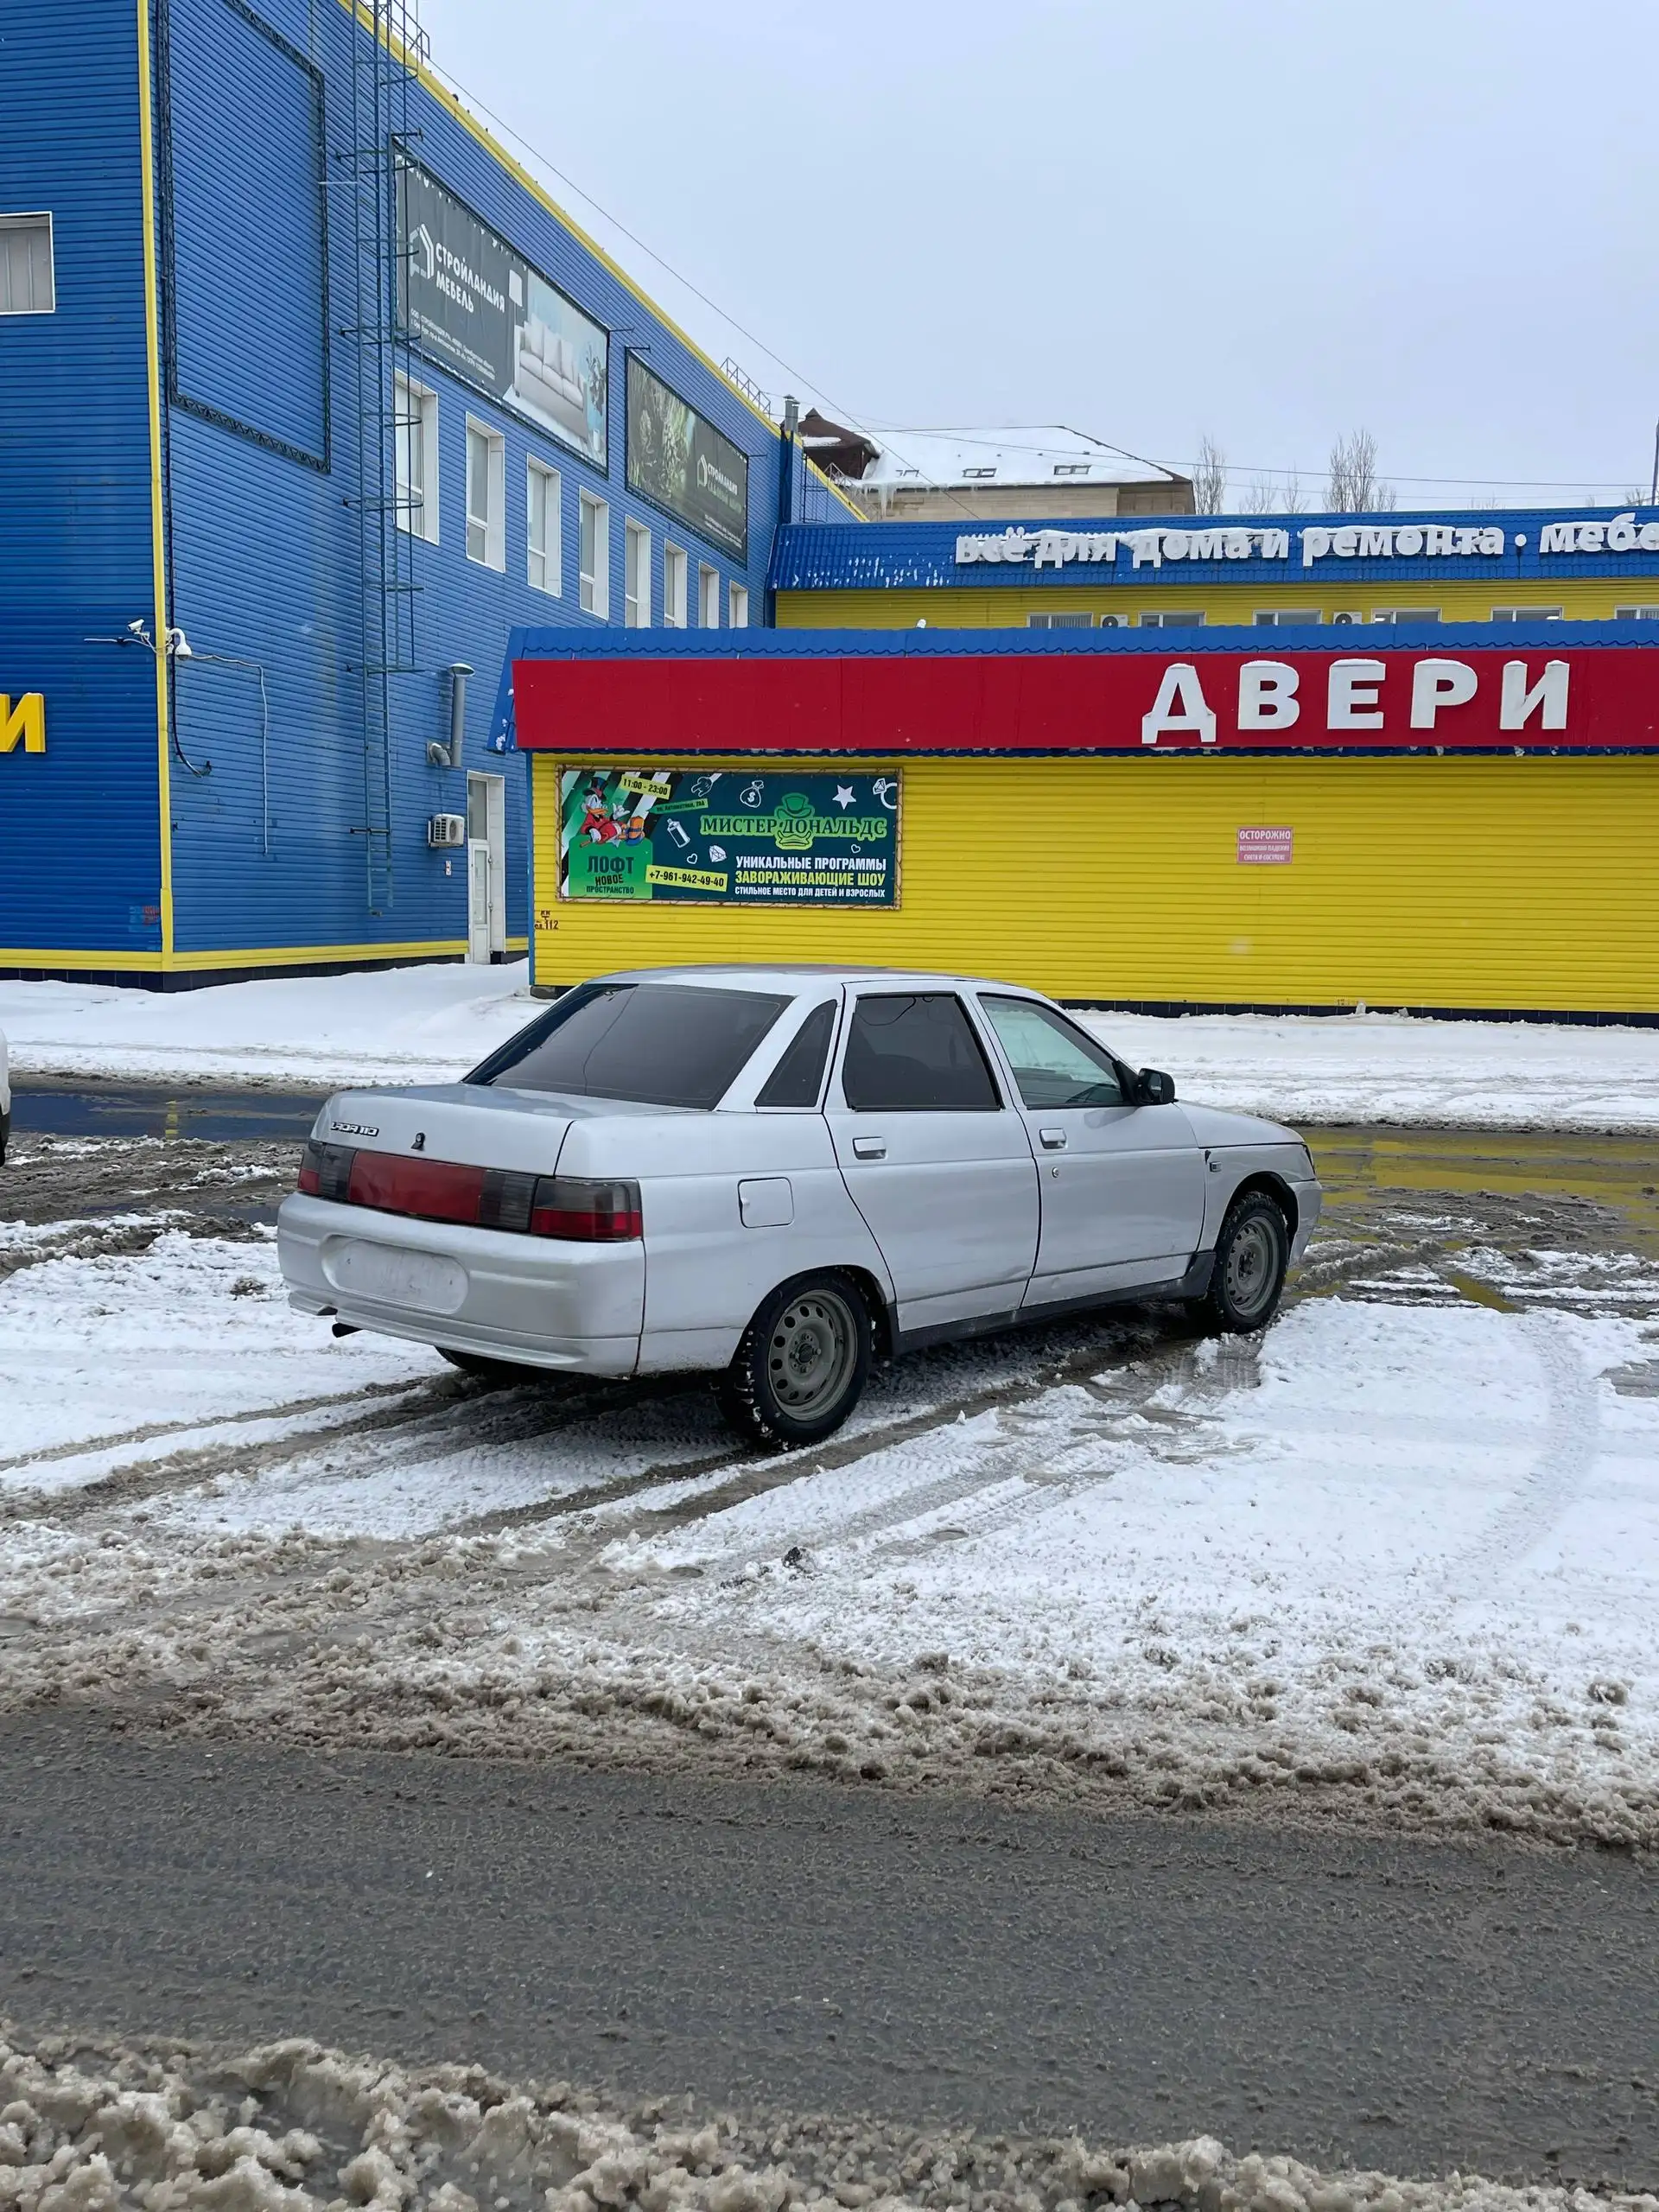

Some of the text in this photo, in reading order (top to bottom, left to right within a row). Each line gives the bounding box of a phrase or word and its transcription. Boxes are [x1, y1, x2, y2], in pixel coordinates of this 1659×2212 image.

[435, 242, 505, 314] СТРОЙЛАНДИЯ
[435, 270, 474, 314] МЕБЕЛЬ
[956, 526, 1027, 563] всё
[1033, 532, 1116, 569] для
[1132, 531, 1249, 569] дома
[1262, 529, 1290, 559] и
[1301, 525, 1504, 567] ремонта
[1141, 658, 1570, 745] ДВЕРИ
[622, 778, 643, 791] 11:00
[648, 783, 668, 796] 23:00
[702, 817, 886, 839] МИСТЕР ДОНАЛЬДС
[1239, 830, 1291, 840] ОСТОРОЖНО
[587, 855, 635, 874] ЛОФТ
[735, 855, 887, 871] УНИКАЛЬНЫЕ ПРОГРАММЫ
[594, 874, 624, 887] НОВОЕ
[649, 871, 724, 887] +7-961-942-49-40
[734, 870, 886, 887] ЗАВОРАЖИВАЮЩИЕ ШОУ
[586, 886, 634, 894] ПРОСТРАНСТВО
[734, 887, 886, 899] СТИЛЬНОЕ МЕСТО ДЛЯ ДЕТЕЙ И ВЗРОСЛЫХ
[330, 1121, 360, 1134] LADA
